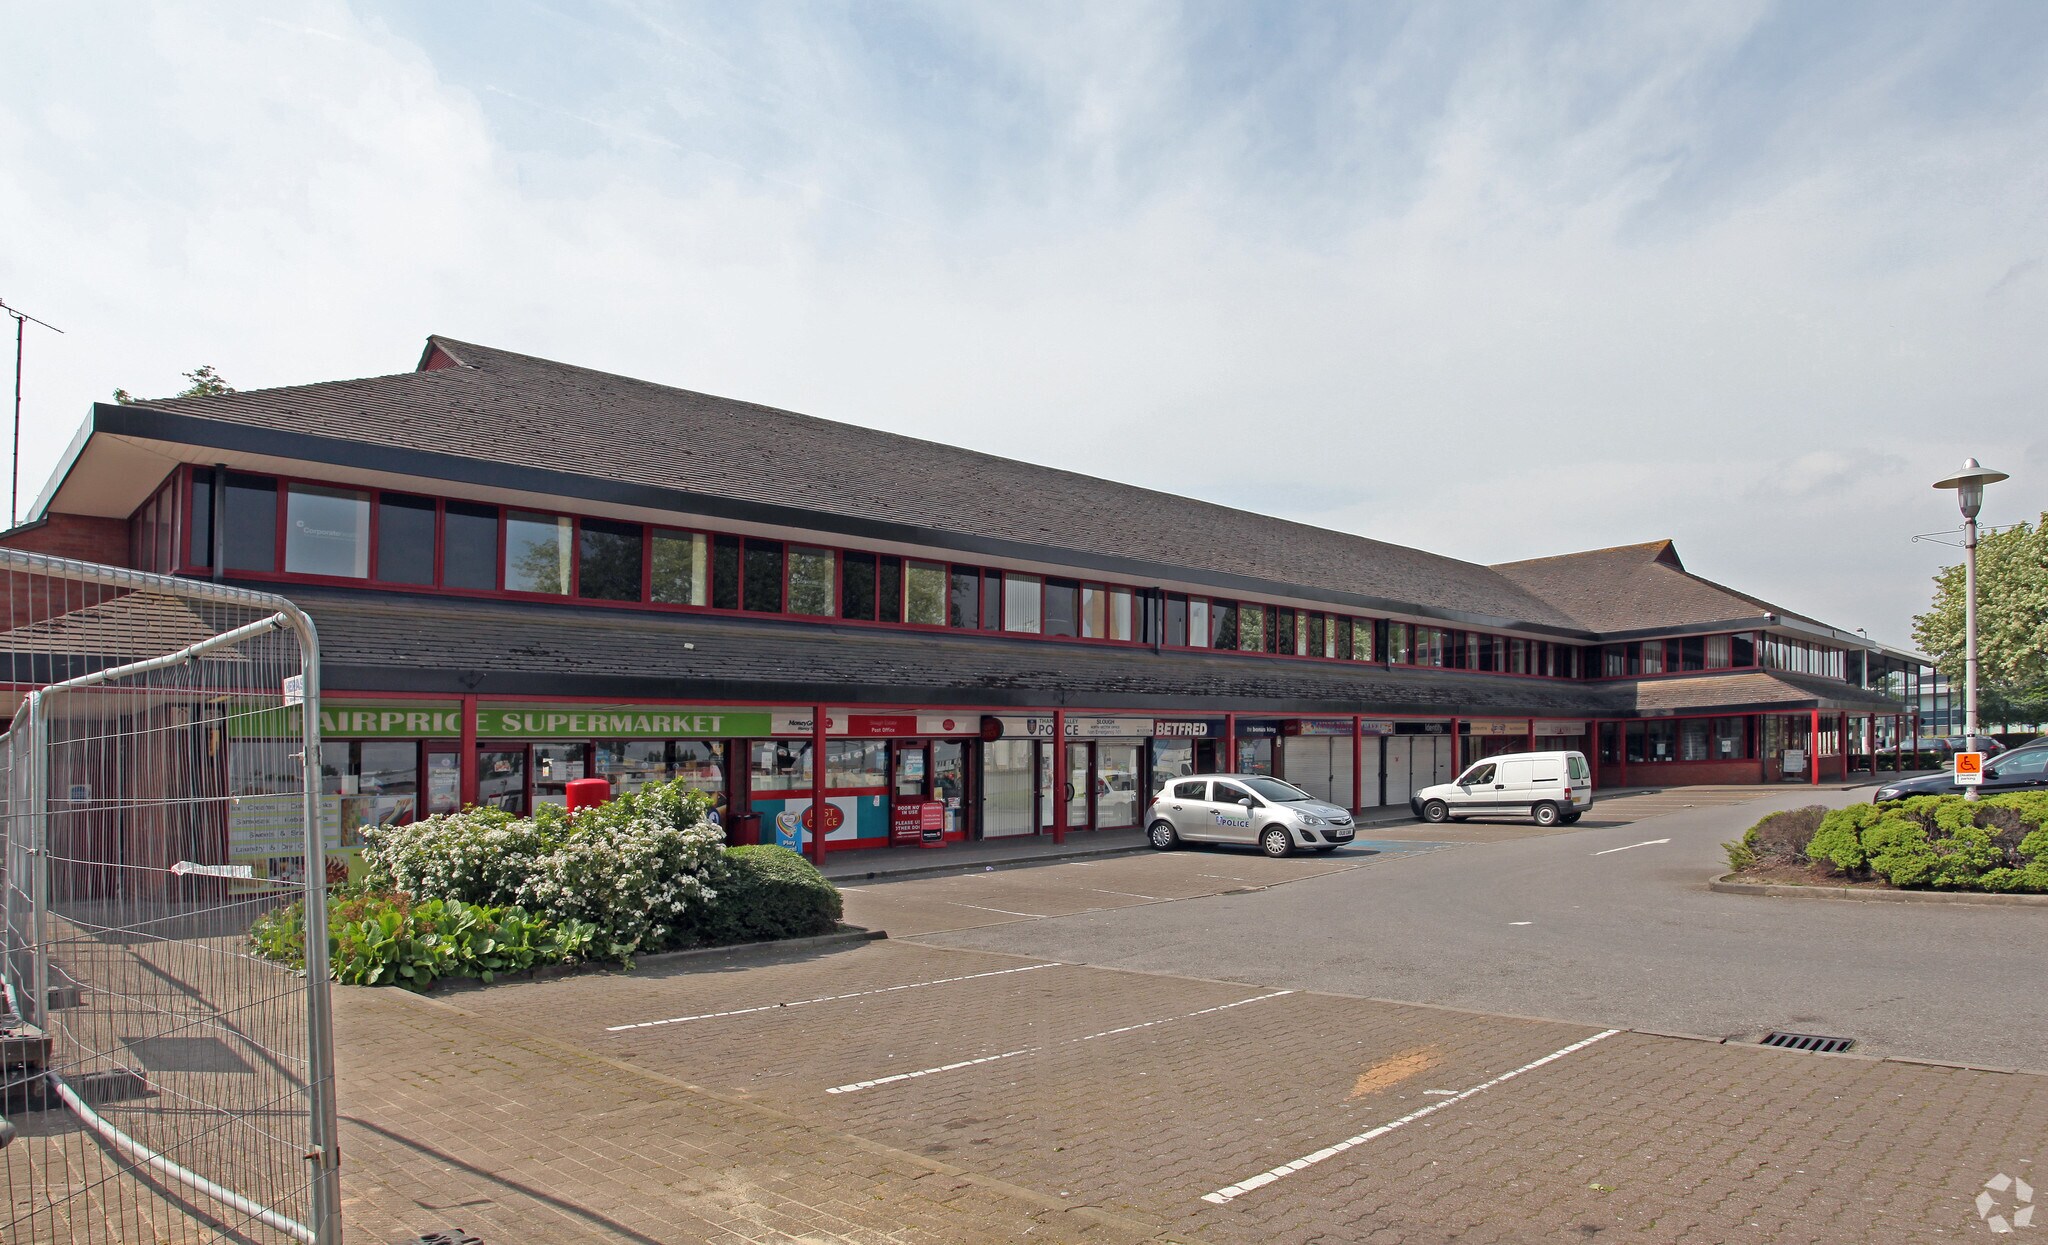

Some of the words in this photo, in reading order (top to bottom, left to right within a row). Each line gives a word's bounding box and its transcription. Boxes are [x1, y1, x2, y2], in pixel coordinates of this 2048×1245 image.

[303, 527, 342, 537] Corporate
[502, 713, 724, 733] SUPERMARKET
[1038, 724, 1079, 736] POCE
[1156, 722, 1208, 736] BETFRED
[1266, 726, 1277, 734] king
[1222, 819, 1250, 828] POLICE
